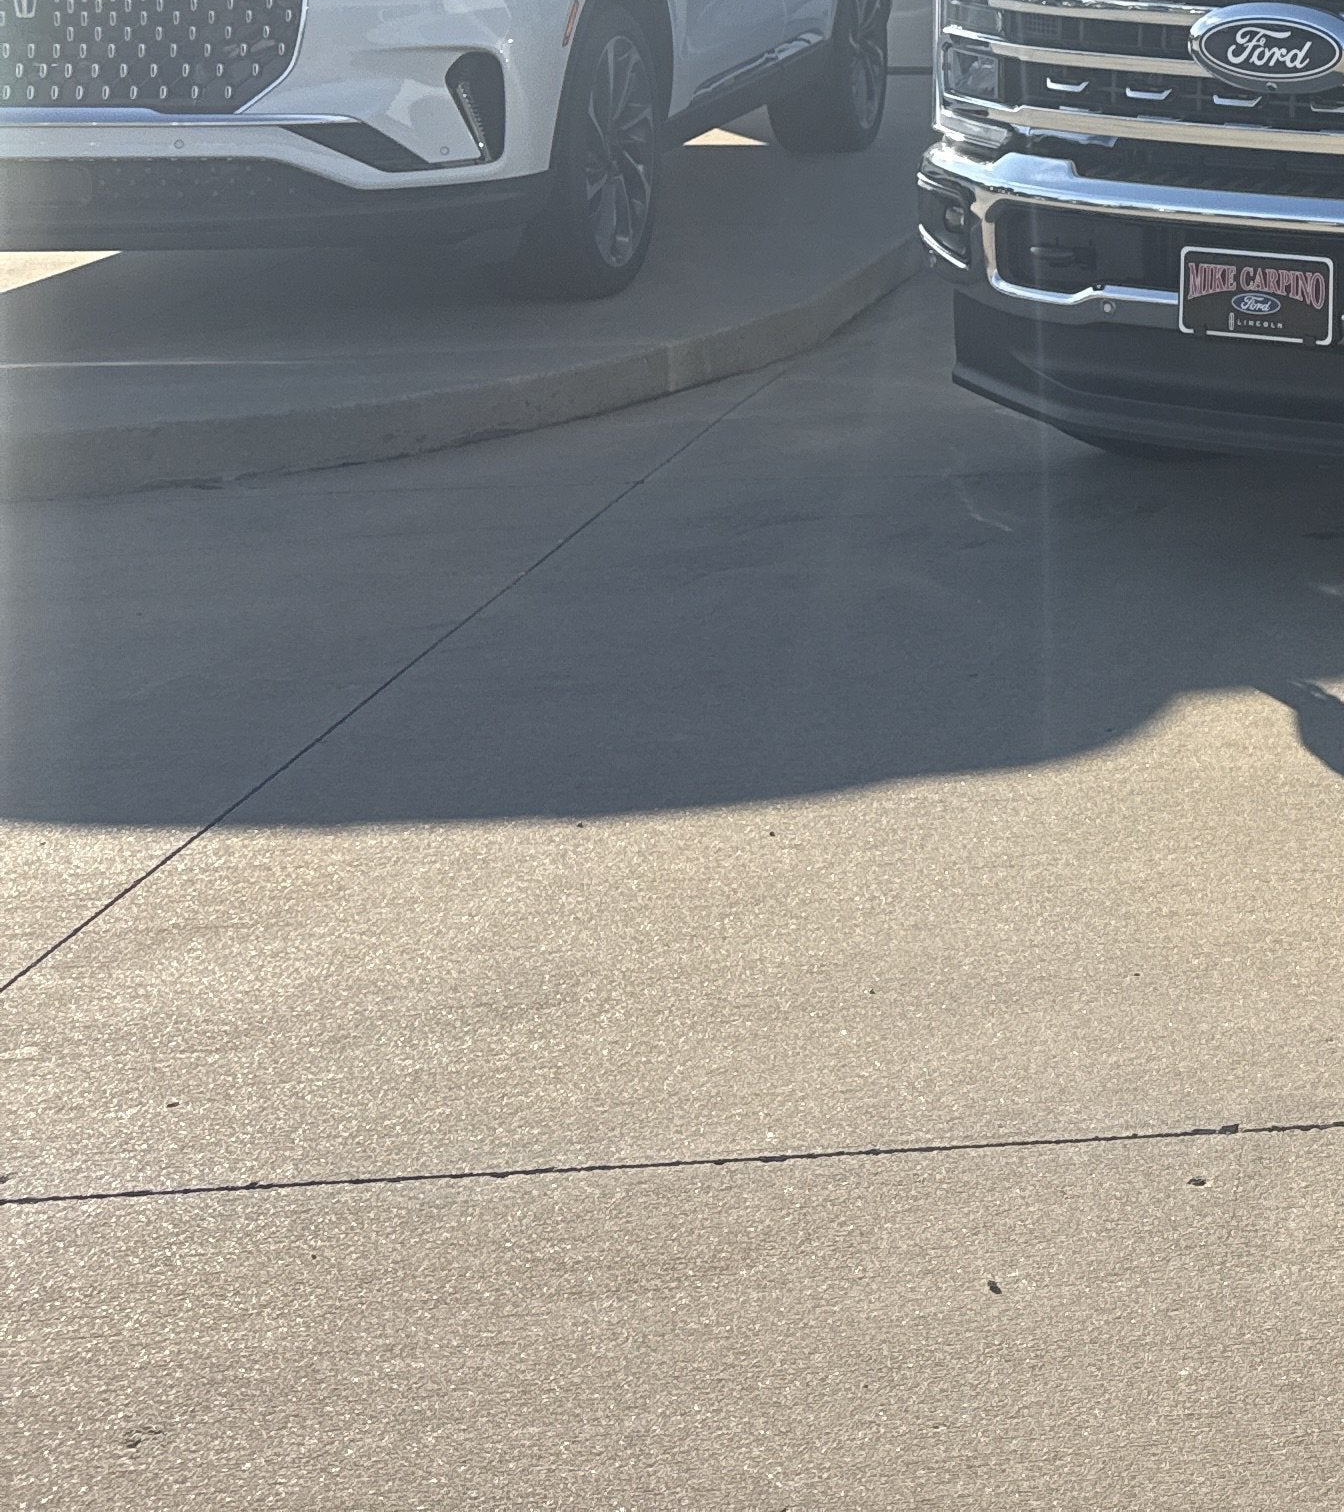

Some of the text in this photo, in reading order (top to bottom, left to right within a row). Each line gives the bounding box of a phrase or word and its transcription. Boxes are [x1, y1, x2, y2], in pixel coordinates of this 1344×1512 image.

[1227, 27, 1313, 68] Ford
[1187, 263, 1326, 310] MIKE CARPINO
[1241, 295, 1271, 311] Ford
[1237, 319, 1283, 329] LINCOLN
